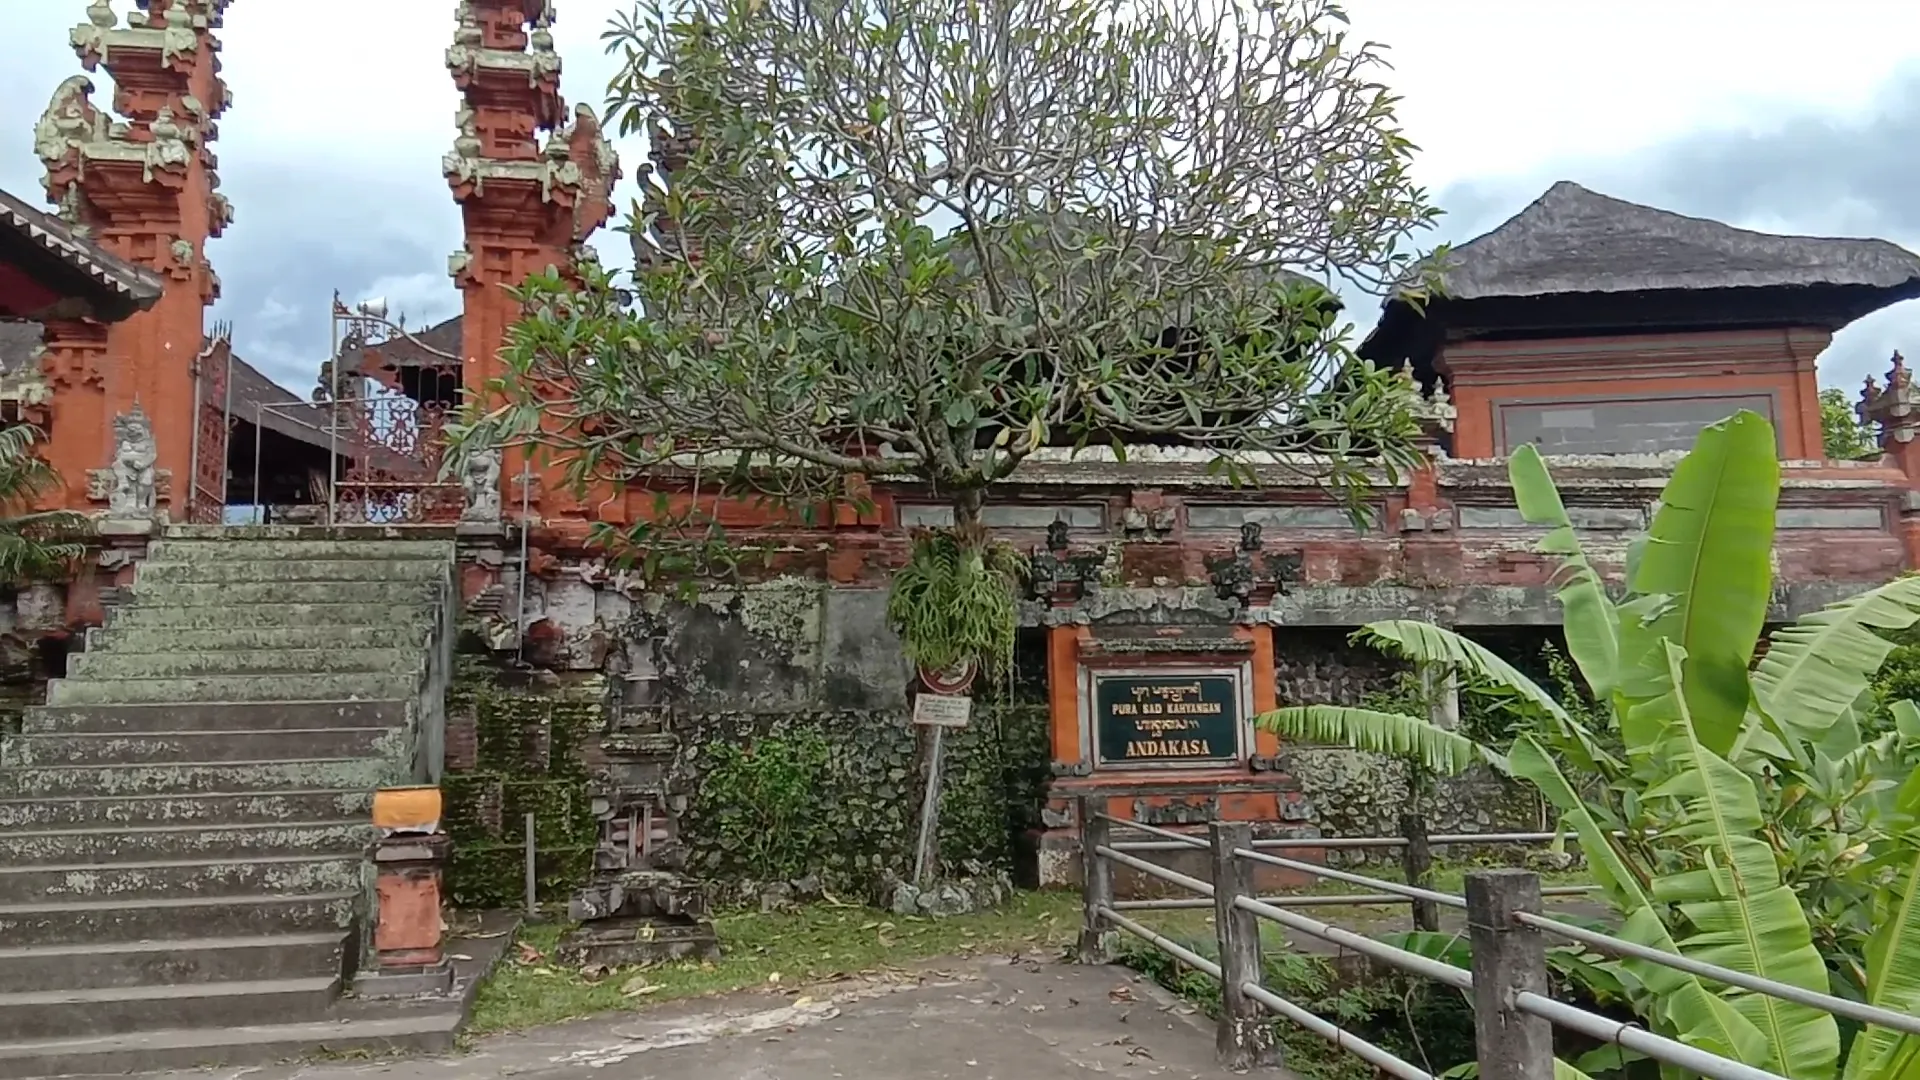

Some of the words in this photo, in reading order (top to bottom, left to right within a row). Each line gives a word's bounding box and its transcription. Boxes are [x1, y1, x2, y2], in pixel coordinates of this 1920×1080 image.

[1111, 703, 1138, 715] PURA
[1143, 703, 1162, 714] SAD
[1167, 702, 1221, 714] KAHYANGAN
[1125, 739, 1211, 757] ANDAKASA
